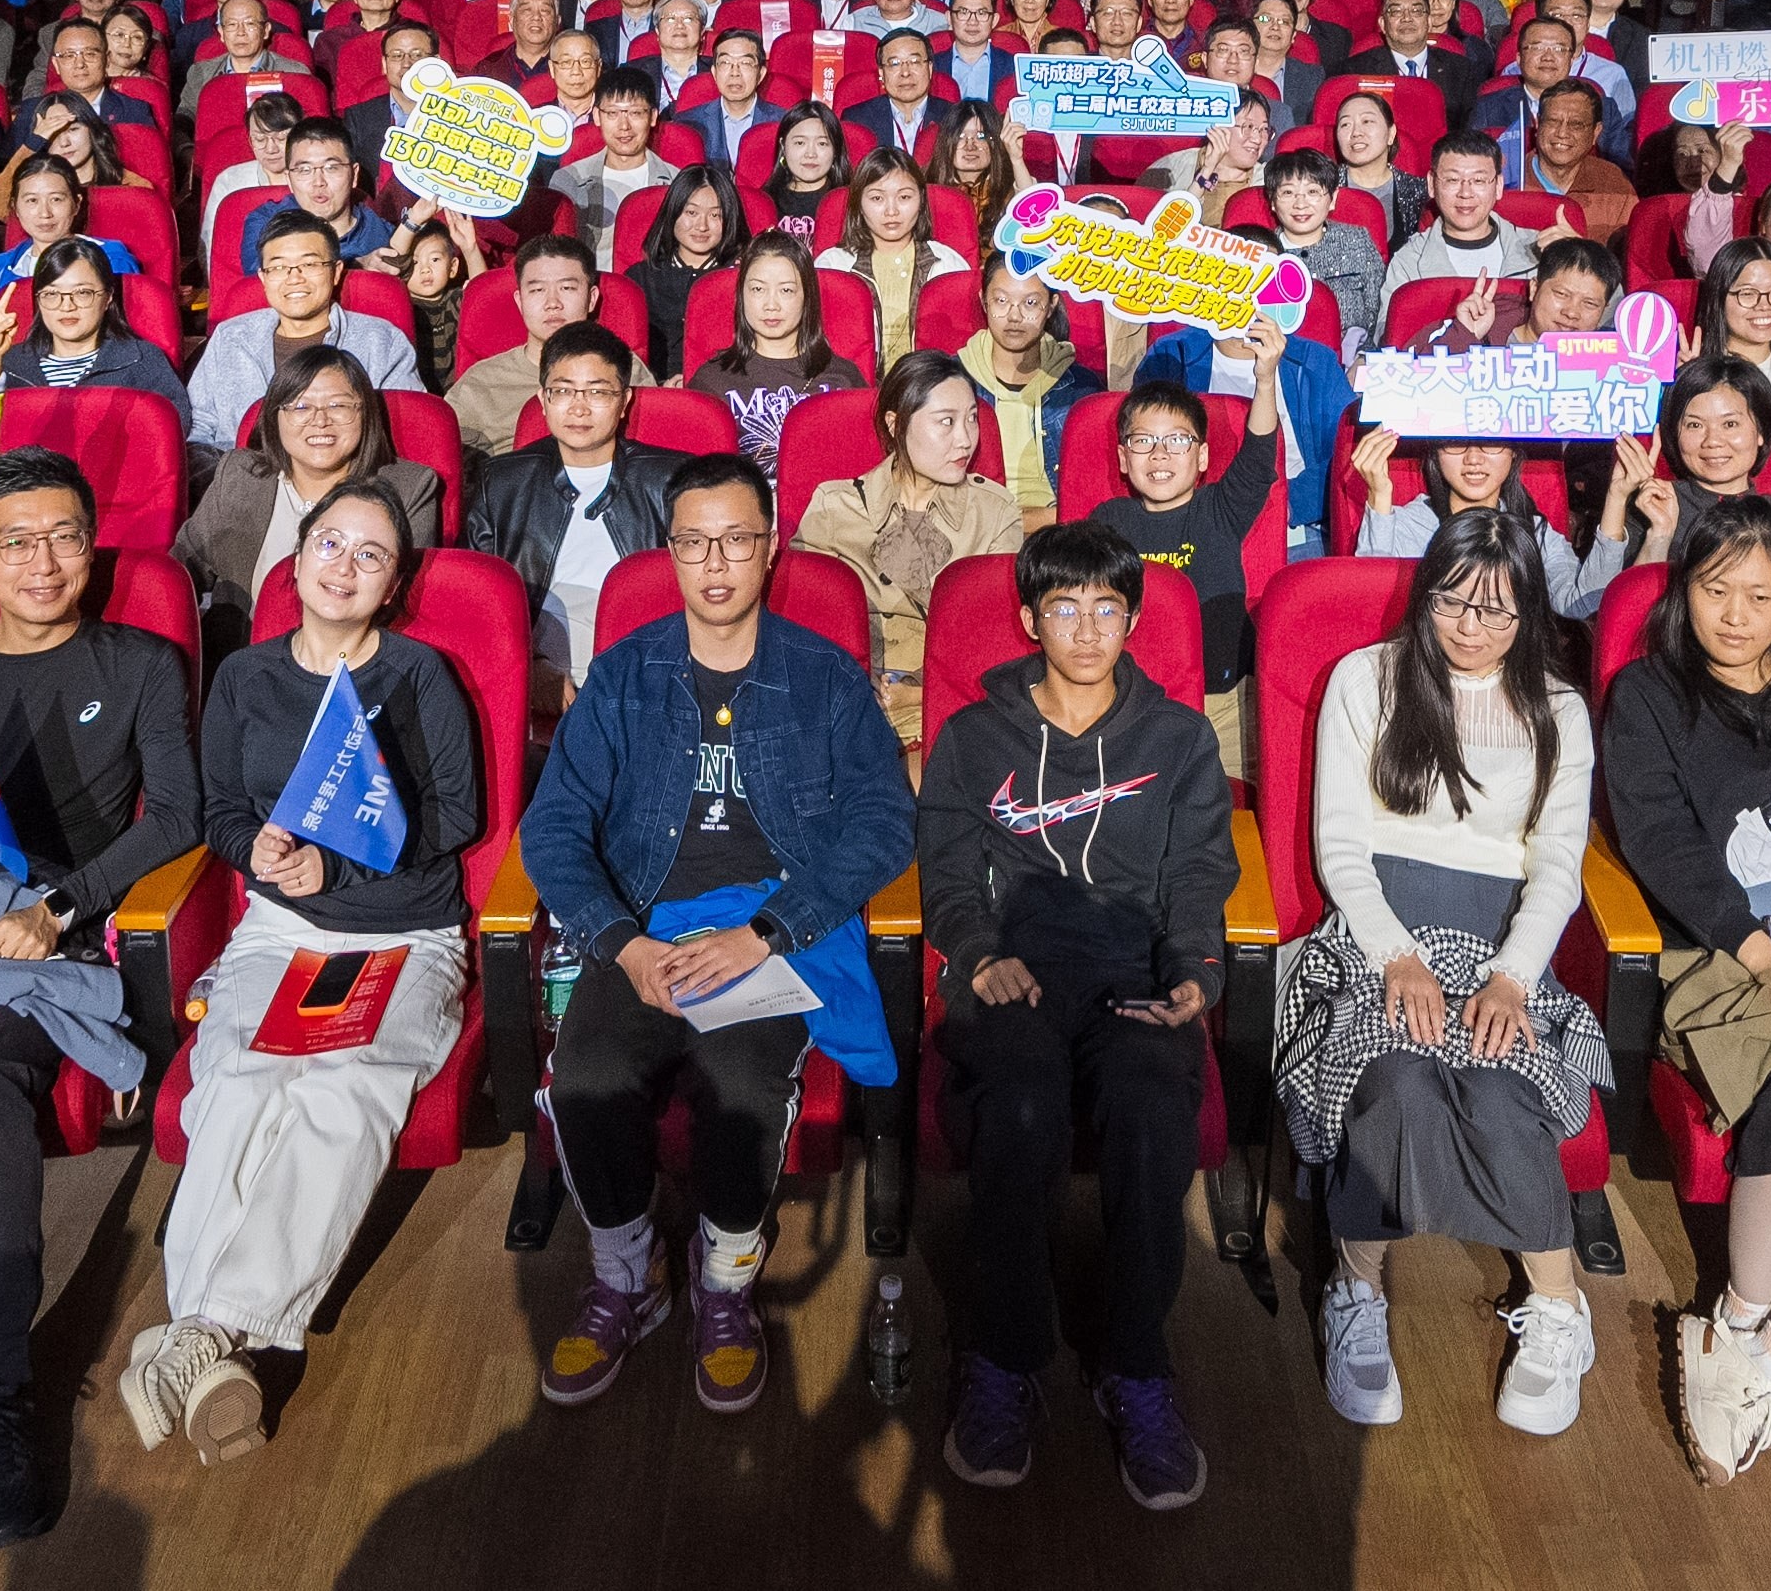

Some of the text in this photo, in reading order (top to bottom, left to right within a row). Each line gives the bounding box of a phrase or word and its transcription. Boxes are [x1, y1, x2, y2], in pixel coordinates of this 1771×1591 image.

[1025, 61, 1137, 95] 骄成超声之夜
[420, 93, 536, 152] 以动人旋律
[460, 91, 513, 120] SJTUME
[1055, 94, 1229, 118] 第二届ME校友音乐会
[1121, 118, 1177, 132] SJTUME
[385, 130, 525, 202] 130周年华诞
[421, 120, 517, 171] 致敬母校
[1186, 225, 1267, 264] SJTUME
[1047, 250, 1258, 333] 机动比你更激动
[1556, 337, 1618, 355] SJTUME
[1365, 345, 1558, 398] 交大机动
[1464, 381, 1653, 435] 我们爱你
